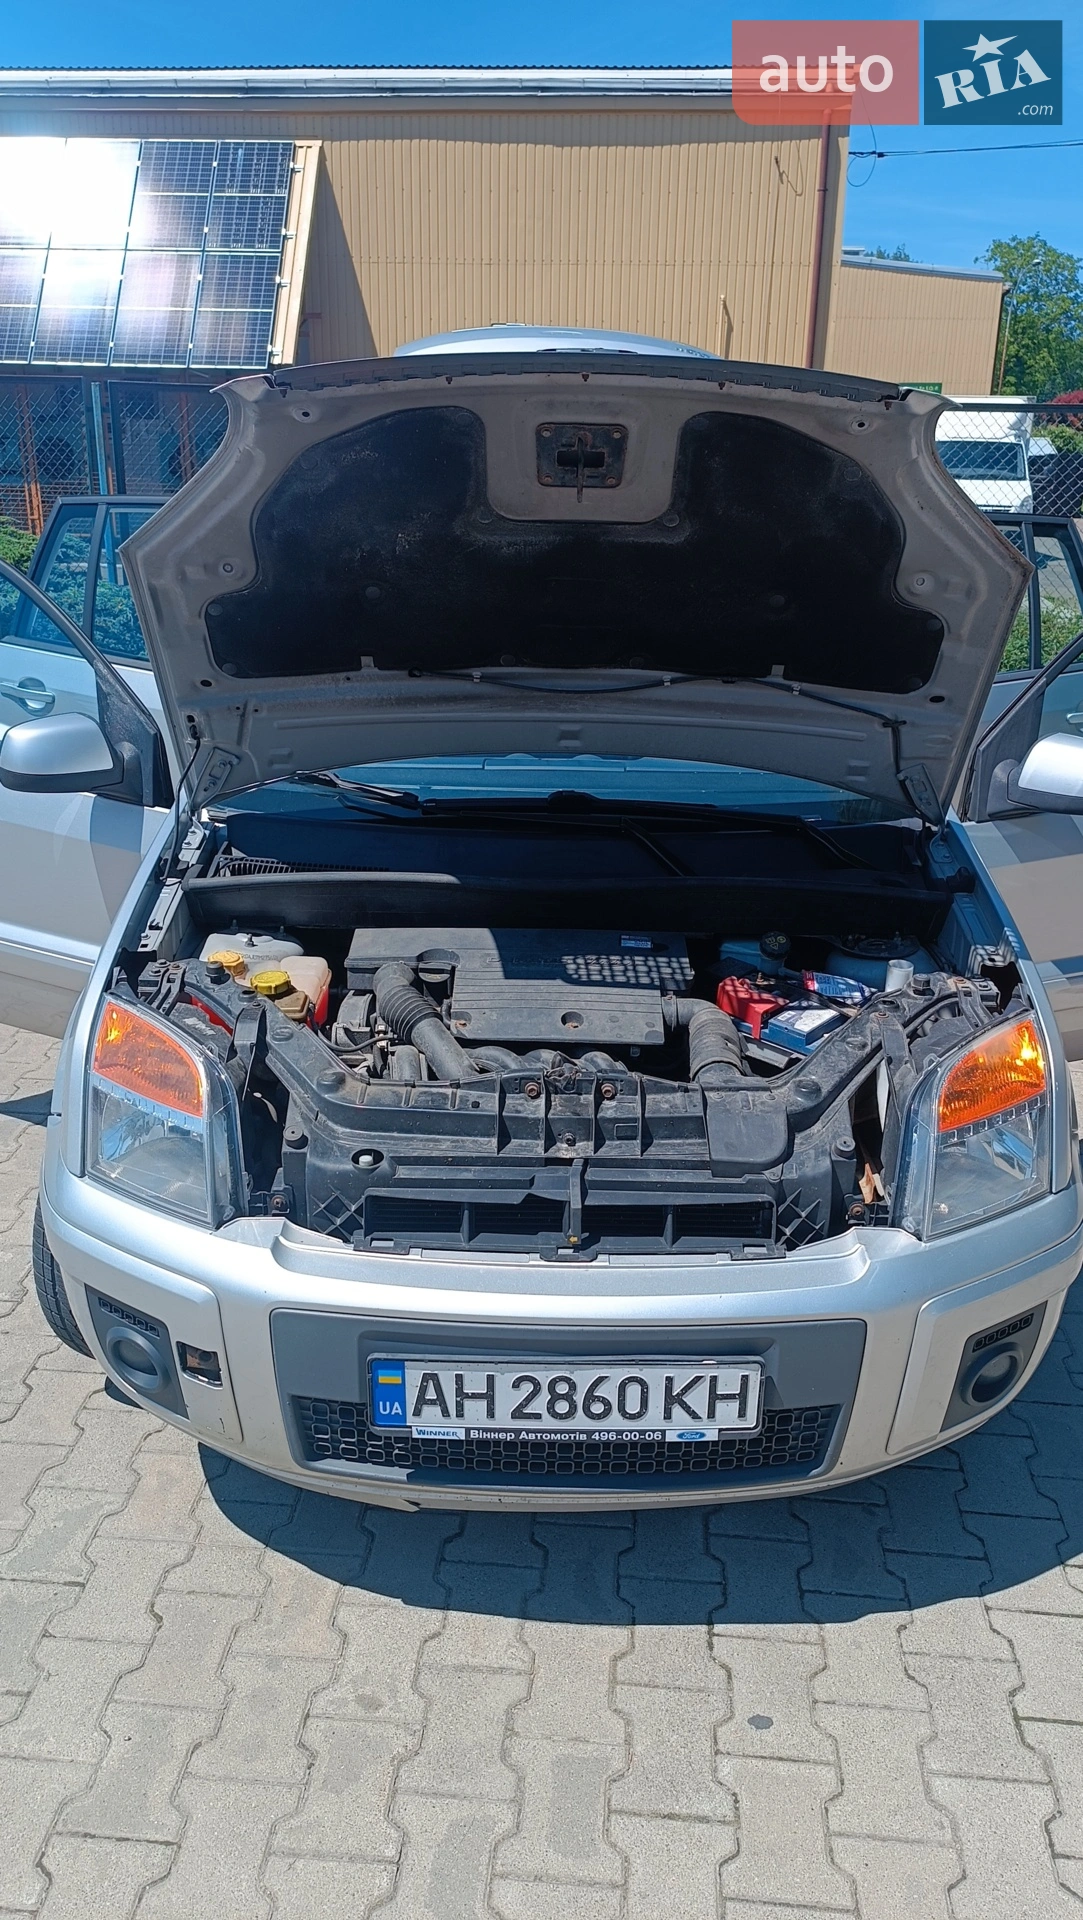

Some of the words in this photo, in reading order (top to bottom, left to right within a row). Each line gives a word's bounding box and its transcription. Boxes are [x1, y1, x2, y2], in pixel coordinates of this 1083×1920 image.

[412, 1372, 495, 1419] AH
[511, 1374, 649, 1420] 2860
[663, 1374, 749, 1420] KH
[379, 1401, 402, 1415] UA
[470, 1430, 515, 1441] Віннер
[519, 1430, 587, 1441] Автомотів
[591, 1431, 662, 1441] 496-00-06
[682, 1431, 701, 1440] Ford
